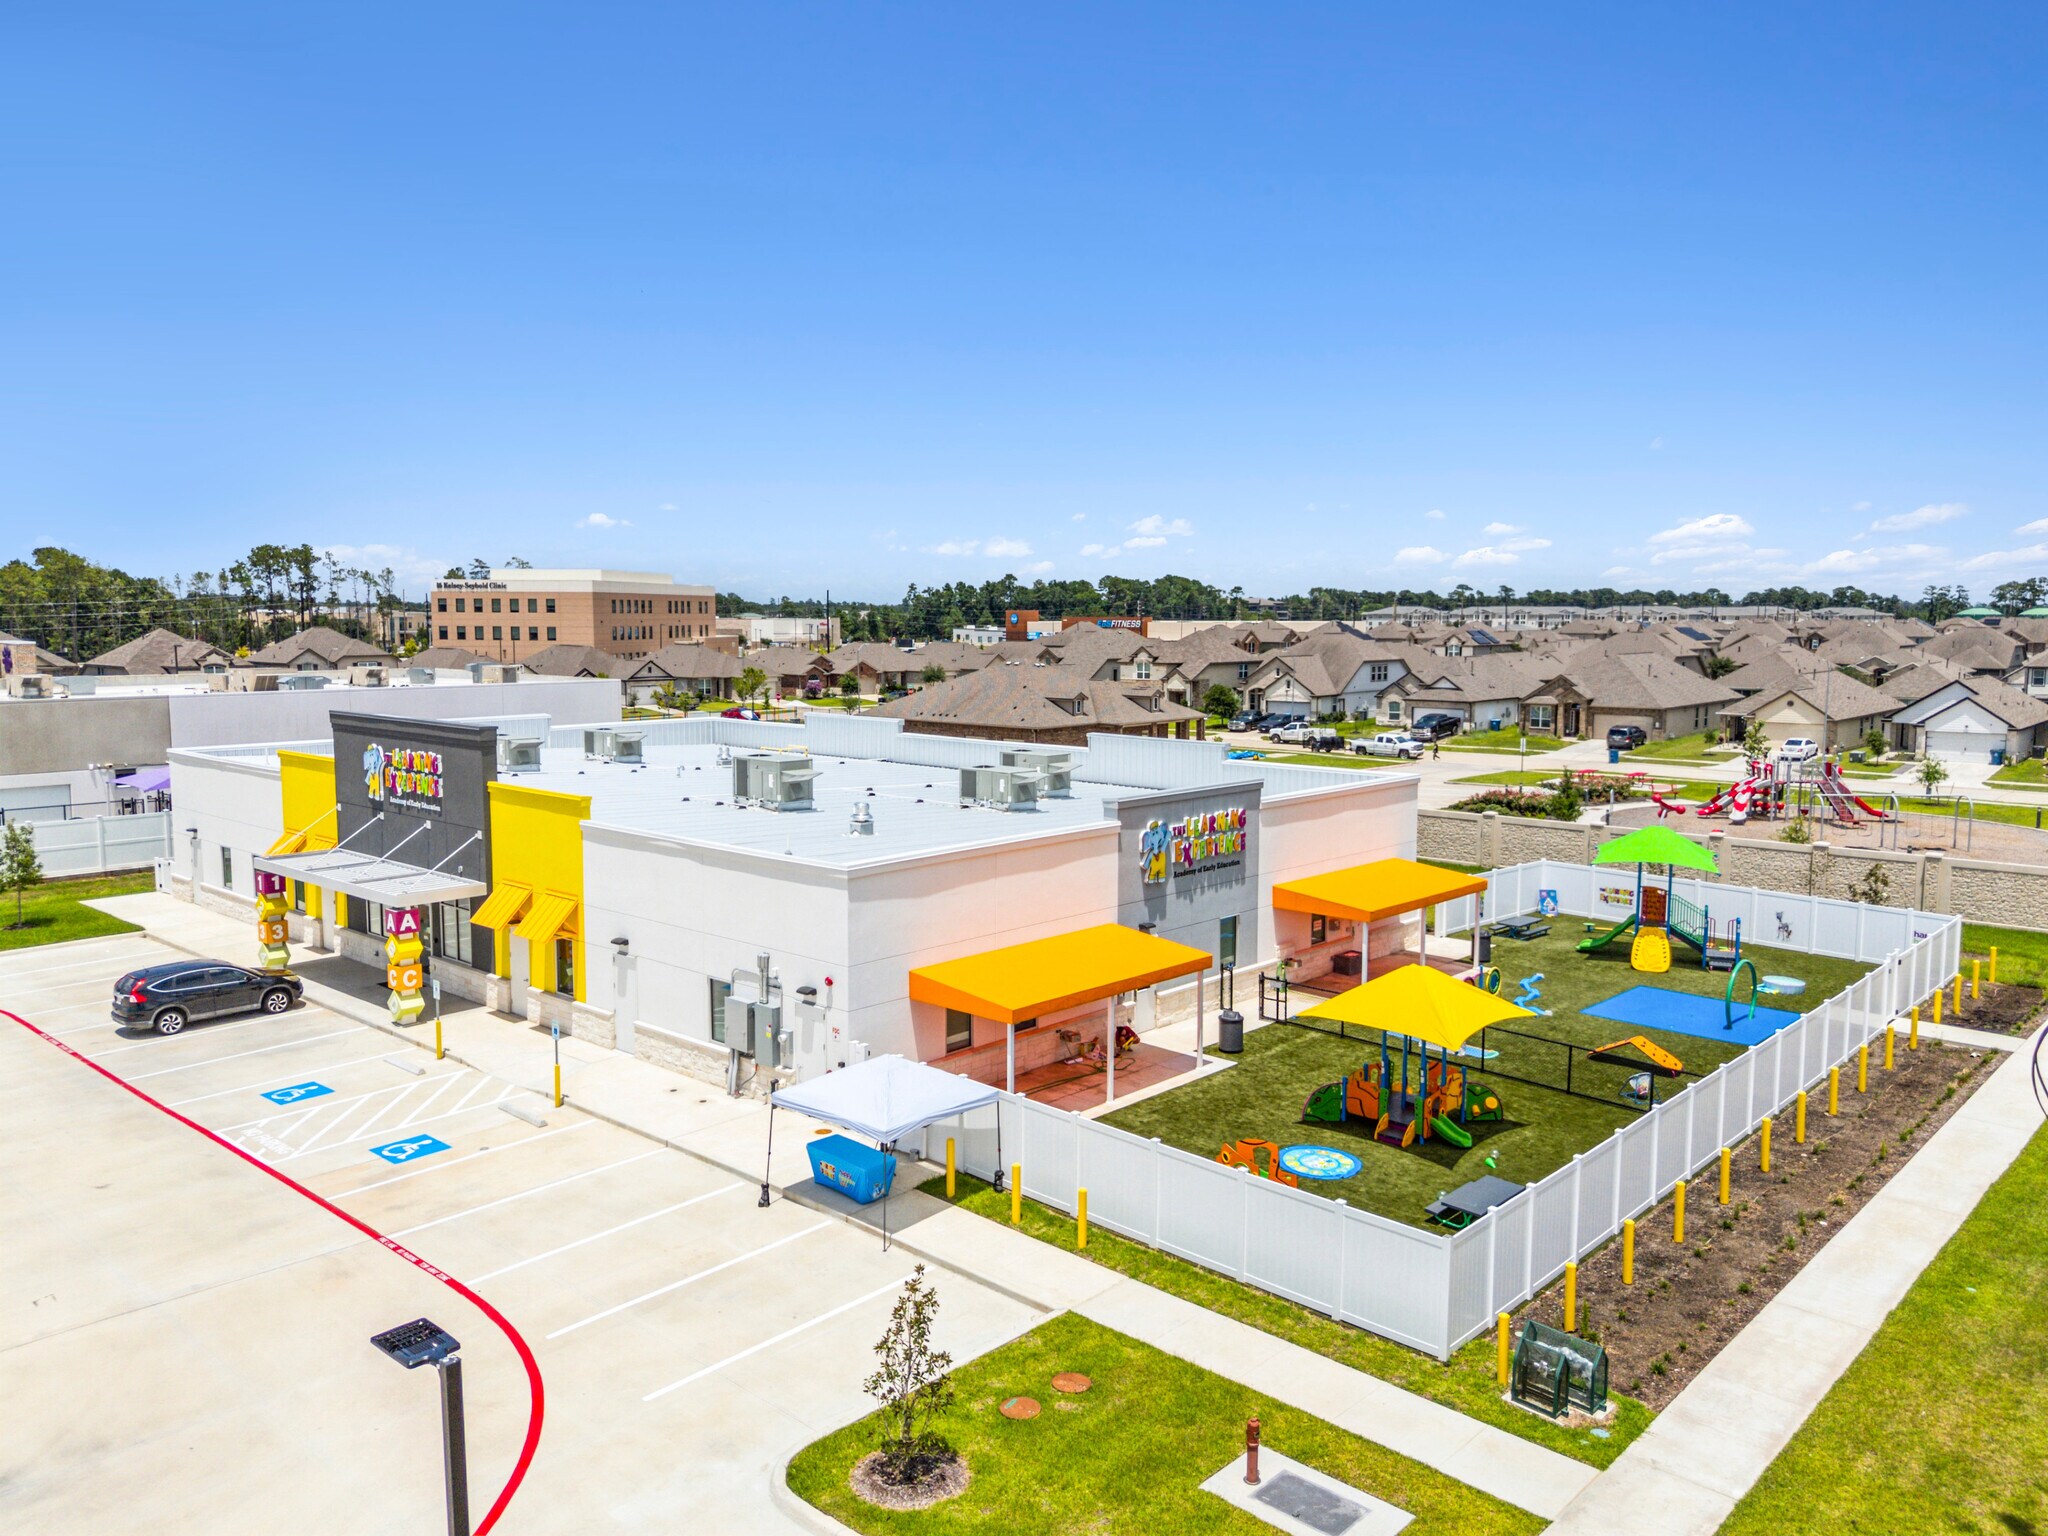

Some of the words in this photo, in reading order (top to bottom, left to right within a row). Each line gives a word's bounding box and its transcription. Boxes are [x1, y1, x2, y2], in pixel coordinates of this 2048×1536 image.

[1111, 620, 1141, 628] FITNESS
[1173, 869, 1197, 879] Academy
[1203, 864, 1216, 872] Early
[1217, 860, 1241, 869] Education
[271, 875, 280, 891] 1
[387, 913, 396, 932] A
[400, 913, 417, 932] A
[260, 924, 266, 940] 3
[272, 924, 284, 940] 3
[389, 969, 397, 987] C
[403, 970, 417, 987] C
